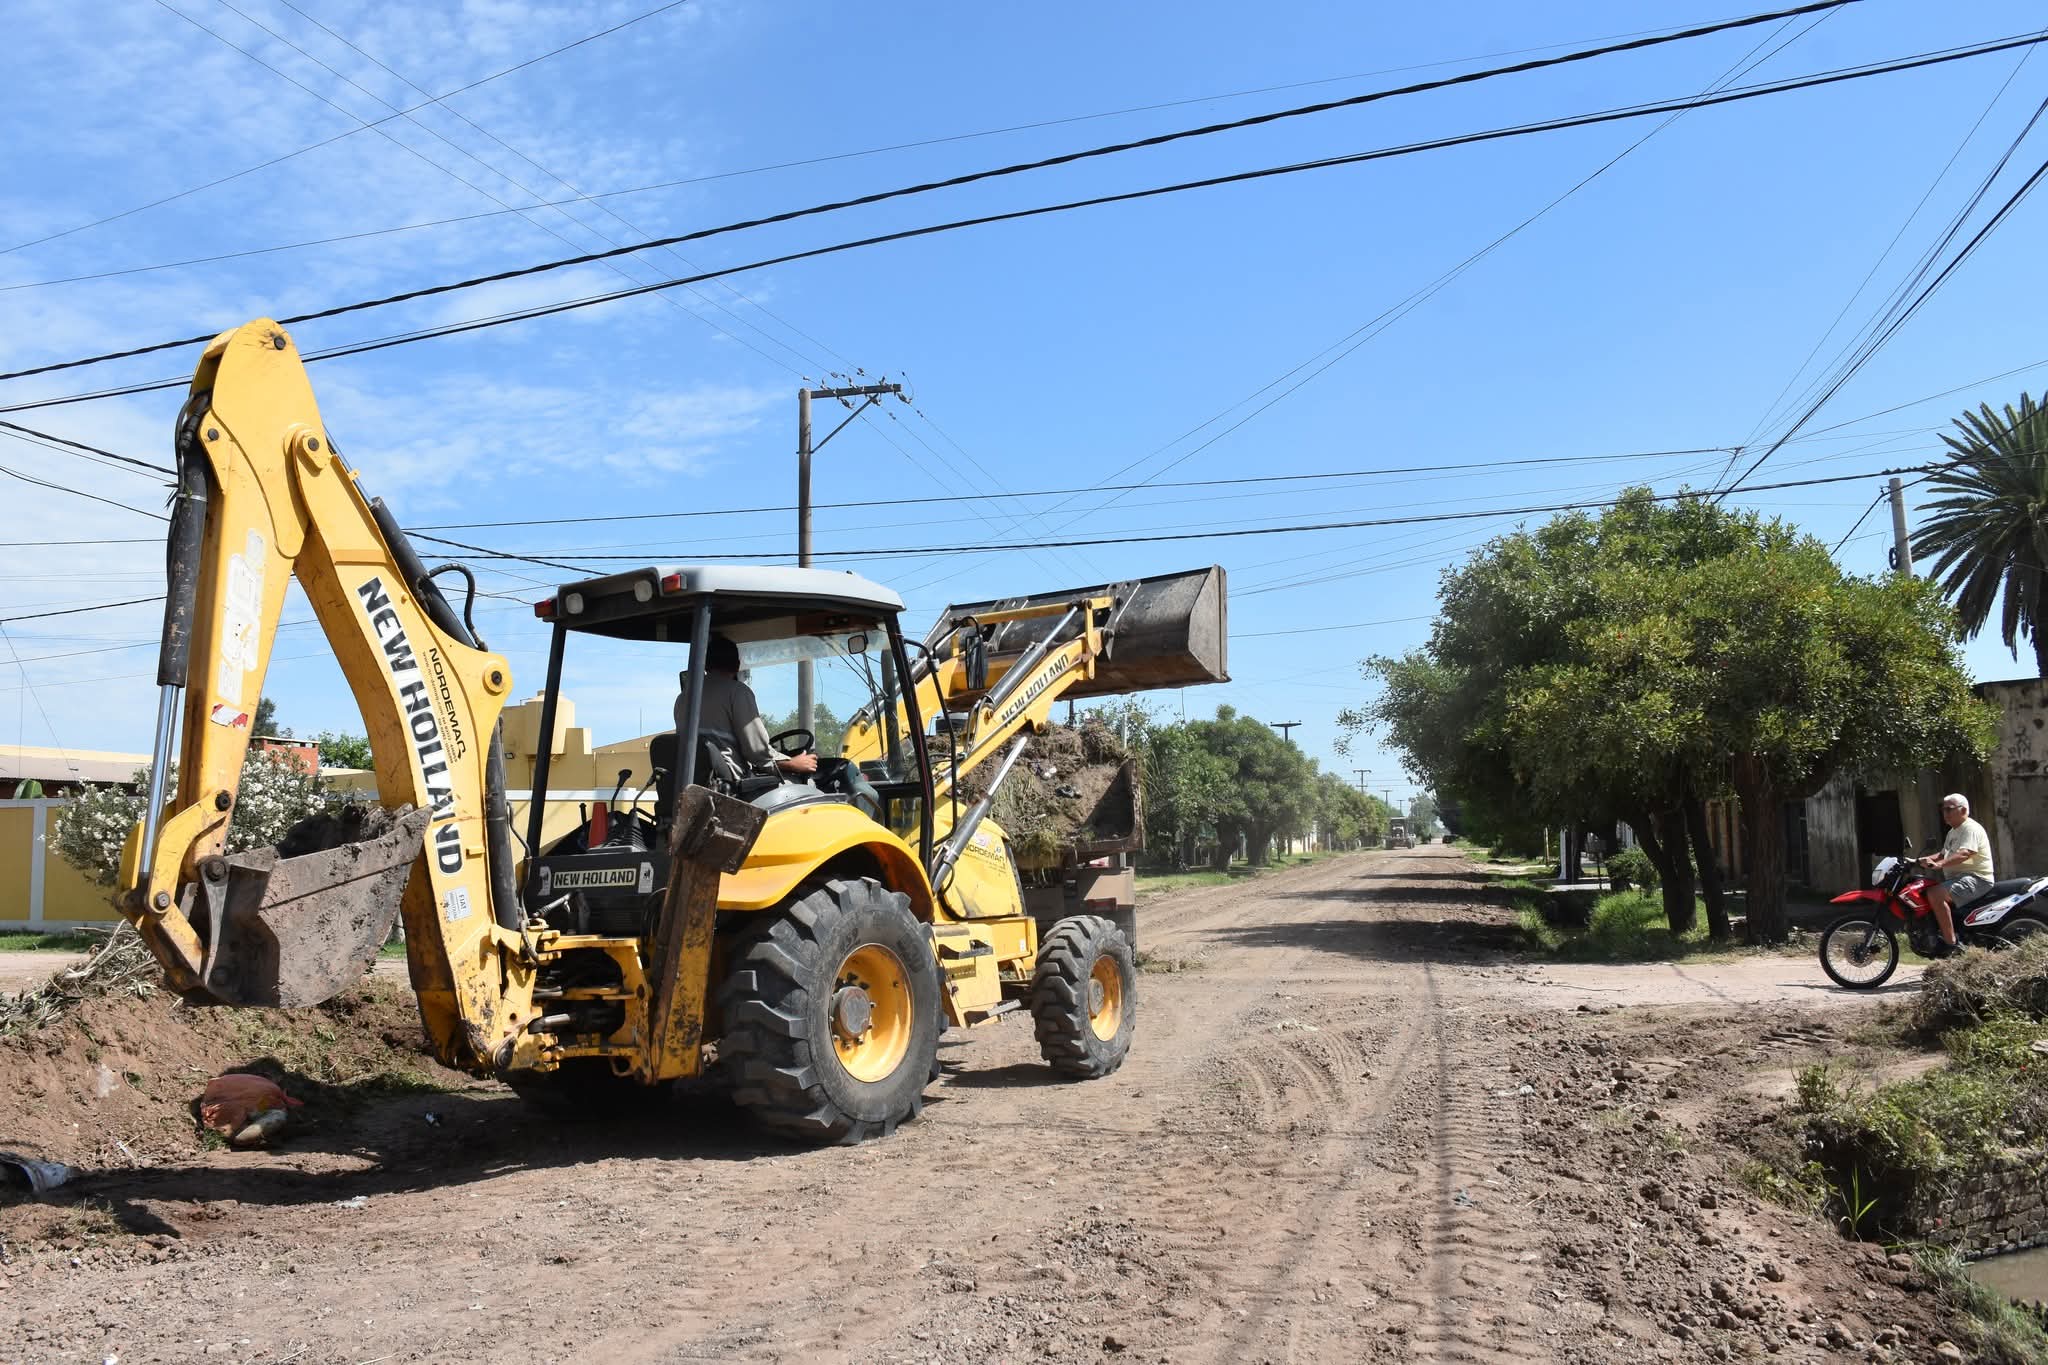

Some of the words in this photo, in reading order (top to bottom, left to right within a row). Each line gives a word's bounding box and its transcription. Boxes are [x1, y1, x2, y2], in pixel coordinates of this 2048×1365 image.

[357, 577, 418, 672] NEW
[400, 680, 462, 873] HOLLAND
[555, 873, 580, 886] NEW
[582, 871, 635, 884] HOLLAND
